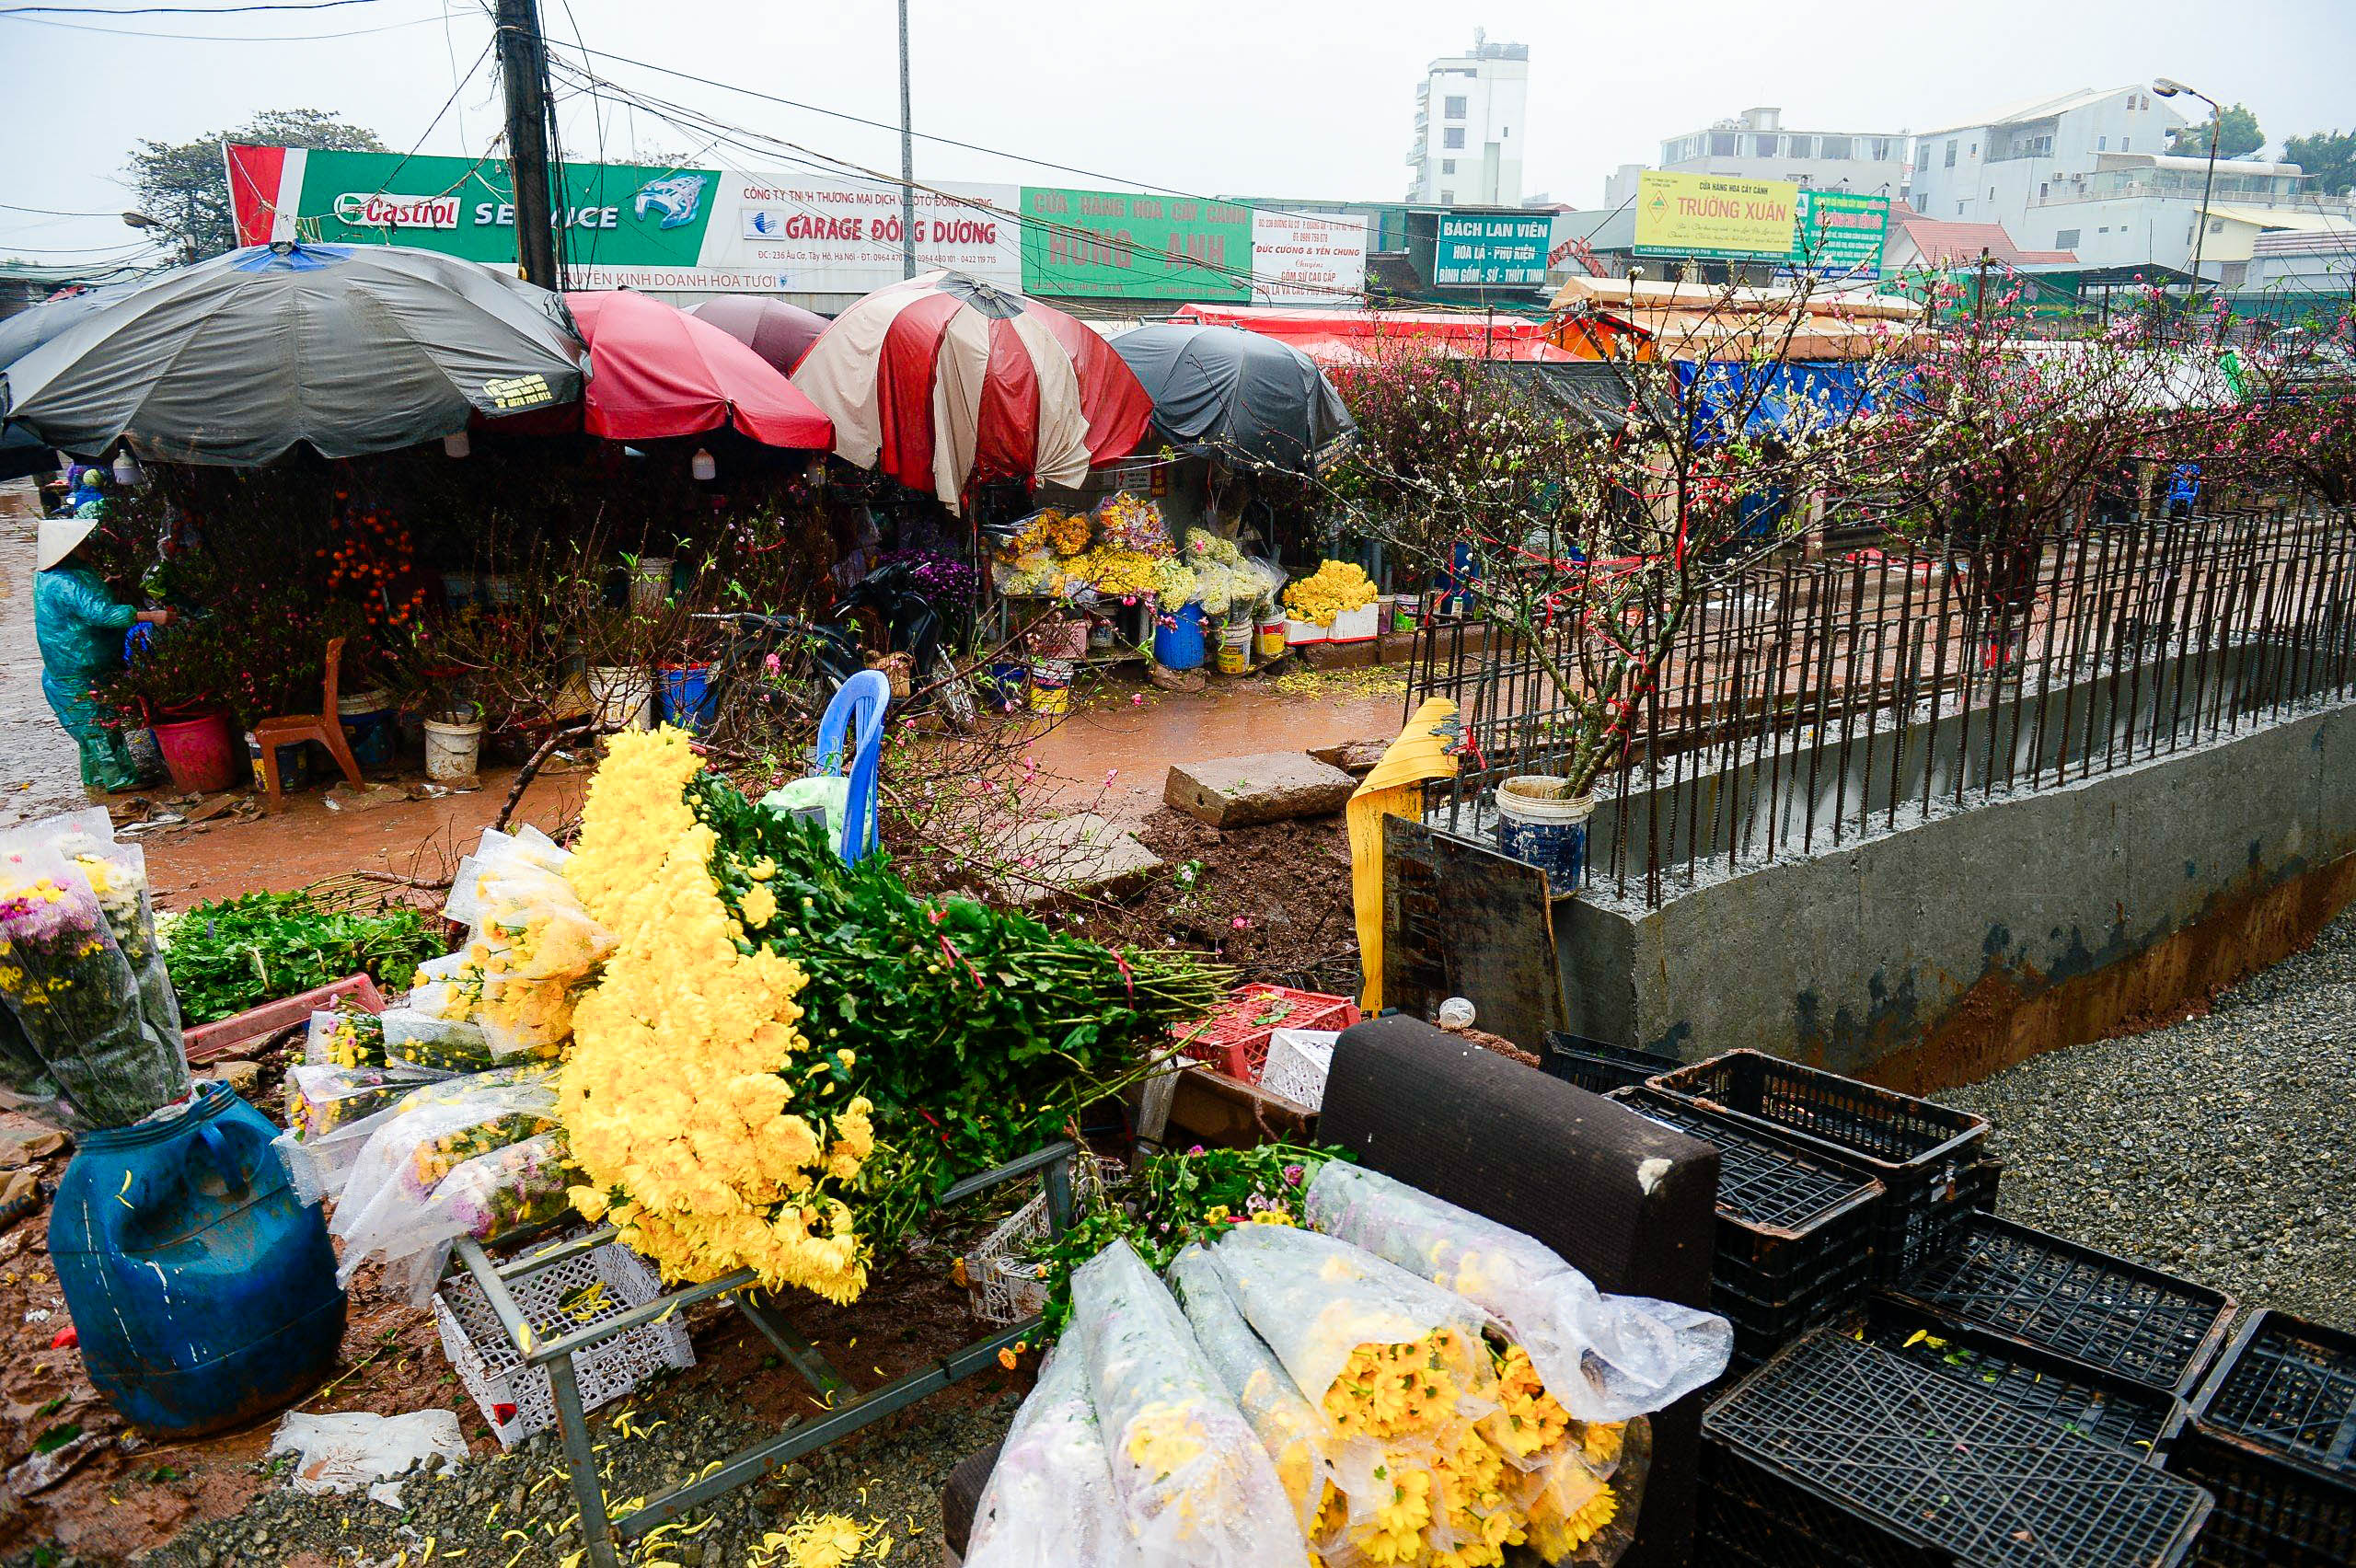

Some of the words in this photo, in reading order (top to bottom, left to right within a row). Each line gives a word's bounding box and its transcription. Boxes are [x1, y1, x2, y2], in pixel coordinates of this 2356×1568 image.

[744, 187, 770, 200] CÔNG
[773, 190, 786, 201] TY
[817, 191, 854, 203] THƯƠNG
[856, 193, 872, 206] MẠI
[876, 194, 895, 206] DỊCH
[1699, 181, 1711, 190] CỬA
[1712, 182, 1727, 192] HÀNG
[1729, 185, 1740, 193] HOA
[1741, 184, 1753, 193] CÂY
[1753, 185, 1769, 195] CẢNH
[366, 198, 456, 225] Castrol
[1133, 200, 1163, 221] HOA
[1678, 195, 1740, 219] TRƯỜNG
[1745, 200, 1787, 221] XUÂN
[786, 216, 862, 240] GARAGE
[933, 219, 997, 244] DƯƠNG
[1443, 220, 1482, 236] BÁCH
[1485, 223, 1513, 237] LAN
[1517, 222, 1548, 237] VIÊN
[773, 251, 784, 259] 236
[809, 252, 820, 262] Tây
[835, 251, 844, 260] Hà
[845, 251, 856, 261] Nội
[1165, 232, 1225, 271] ANH
[1256, 243, 1274, 253] ĐỨC
[1334, 248, 1360, 256] CHUNG
[1453, 245, 1472, 259] HOA
[1474, 243, 1485, 259] LÁ
[1494, 246, 1513, 262] PHỤ
[1514, 244, 1536, 262] KIỆN
[618, 272, 651, 286] KINH
[654, 273, 707, 287] DOANH
[710, 274, 740, 287] HOA
[743, 274, 777, 288] TƯƠI
[1309, 272, 1322, 282] CAO
[1438, 266, 1460, 282] BÌNH
[1461, 264, 1480, 282] GỐM
[1486, 266, 1499, 282] SỨ
[1505, 264, 1525, 282] THỦY
[1526, 268, 1544, 282] TINH
